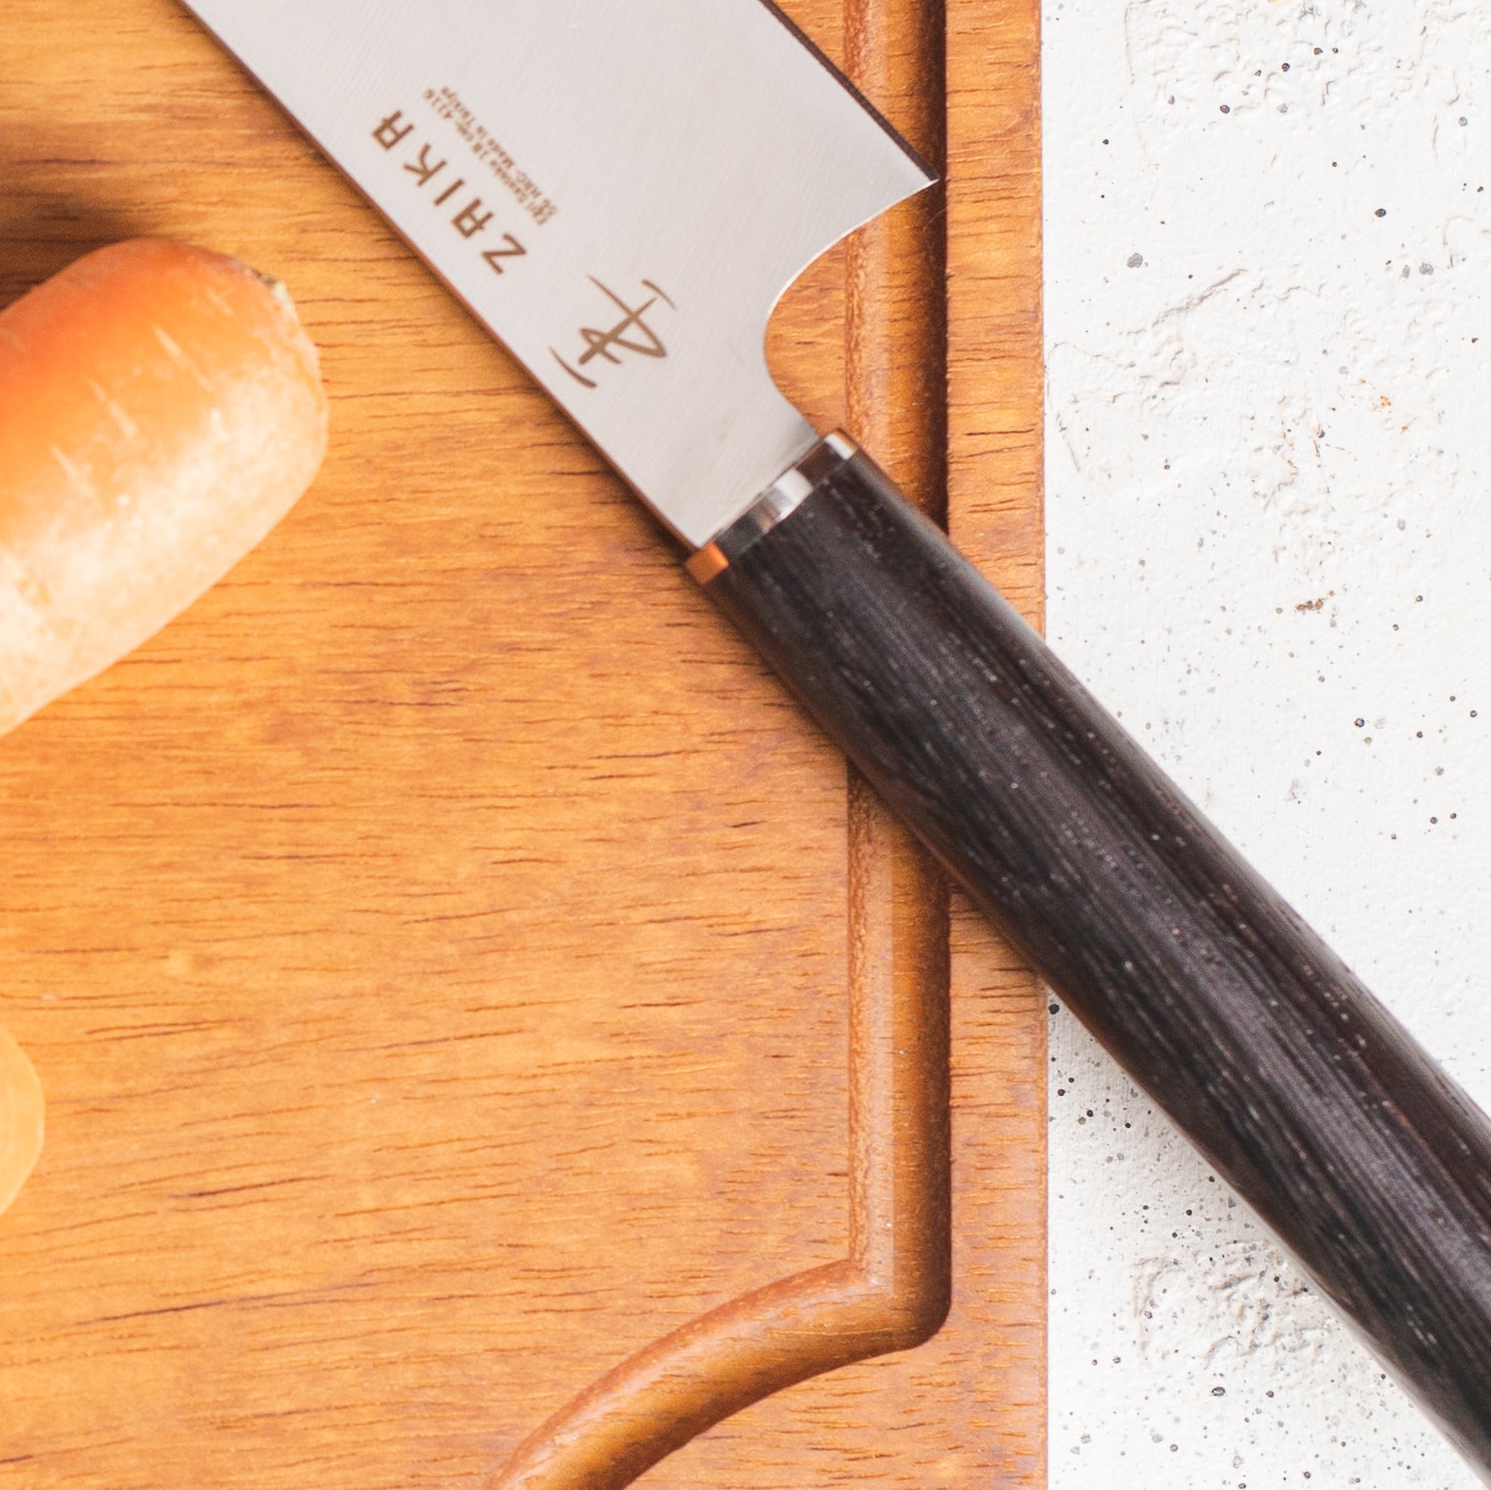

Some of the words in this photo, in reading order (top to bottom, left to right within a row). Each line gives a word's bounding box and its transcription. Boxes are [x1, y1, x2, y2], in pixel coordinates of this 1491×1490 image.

[423, 88, 454, 119] 4116
[486, 138, 515, 170] Made
[372, 110, 527, 274] ZAIKA
